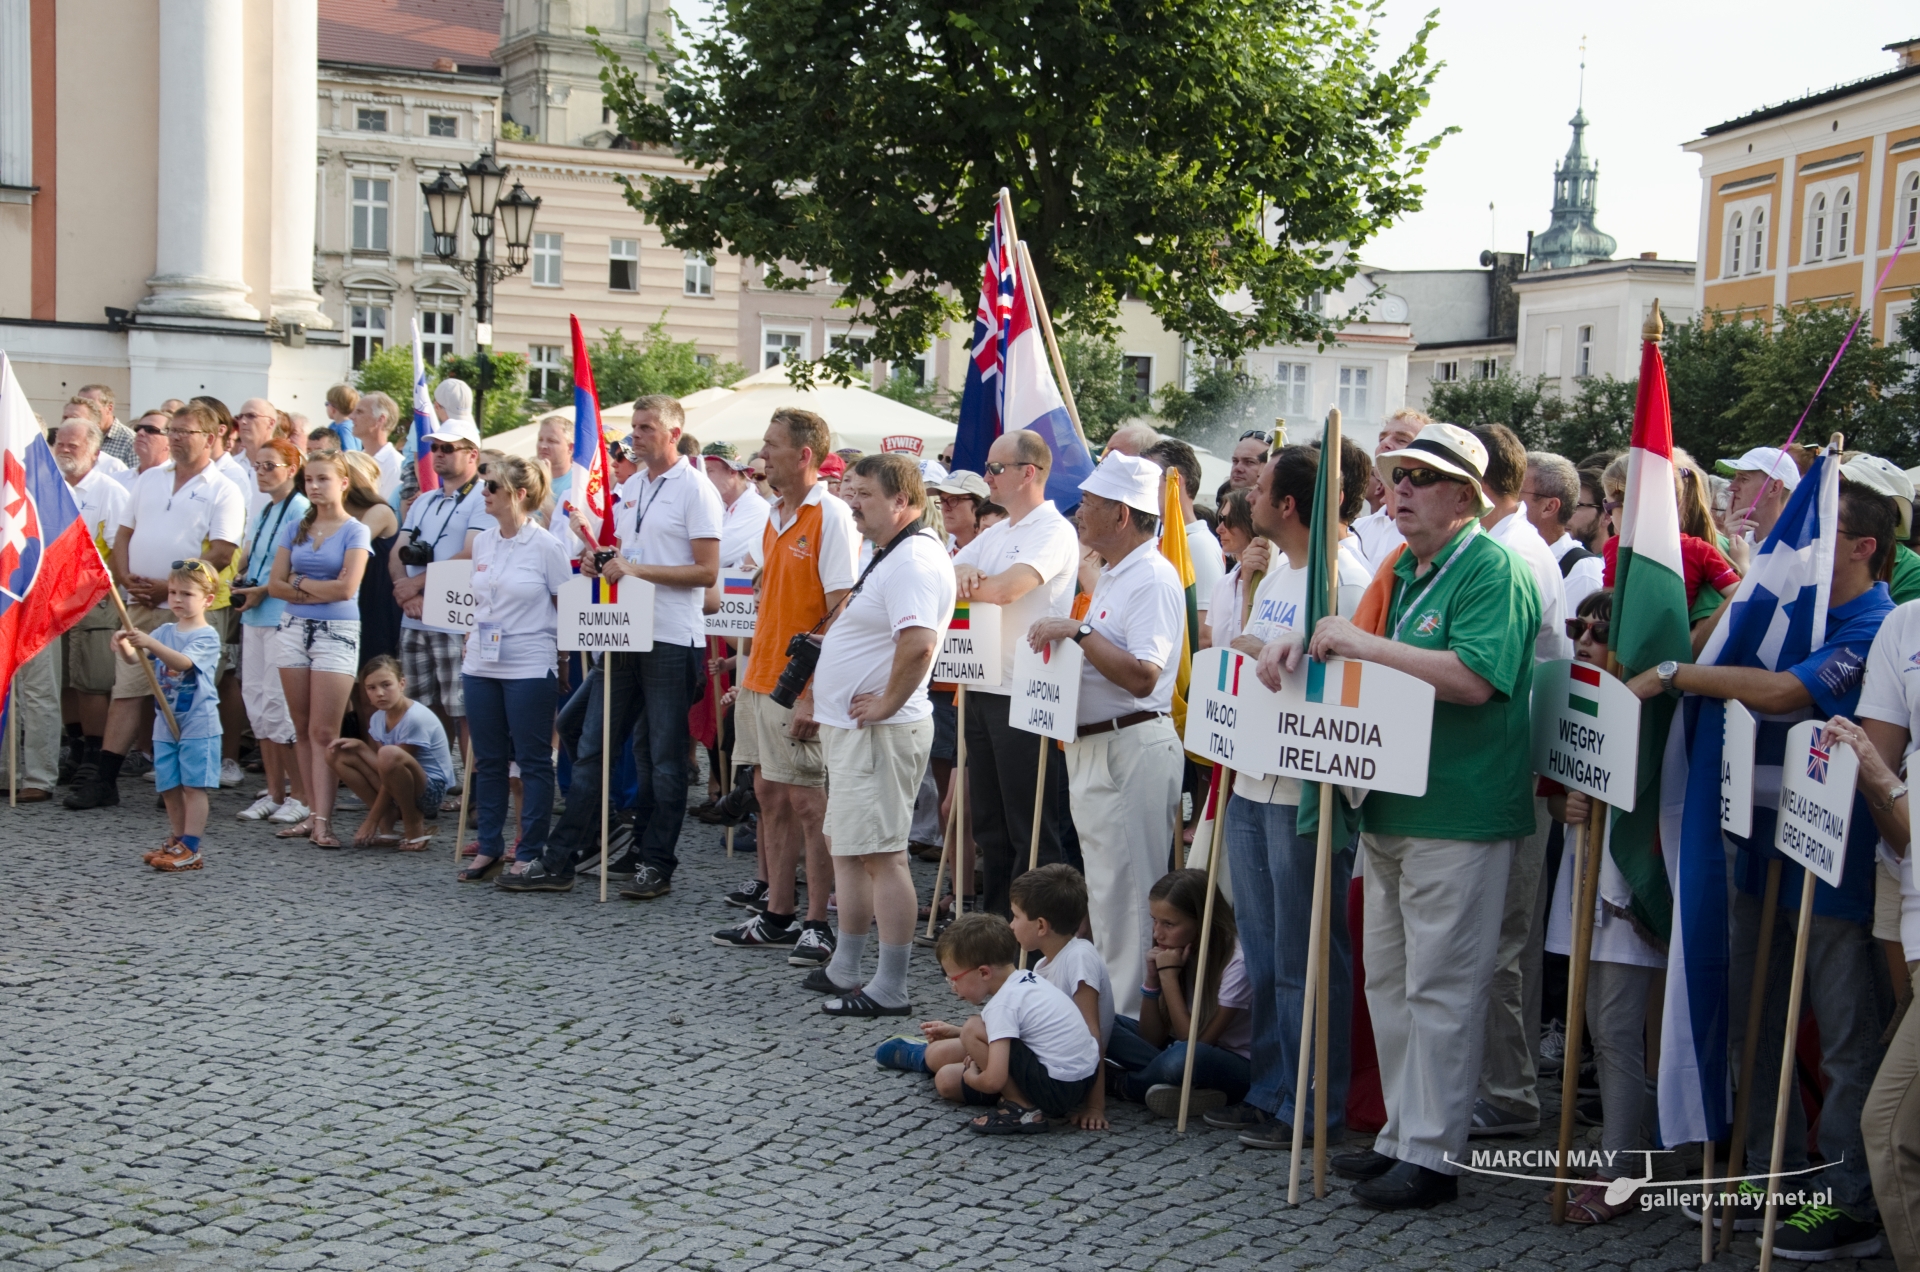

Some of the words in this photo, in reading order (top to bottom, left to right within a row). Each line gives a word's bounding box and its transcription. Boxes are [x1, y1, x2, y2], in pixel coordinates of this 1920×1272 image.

[886, 436, 920, 450] ŻYWIEC
[578, 611, 631, 626] RUMUNIA
[719, 601, 757, 615] ROSJ
[893, 614, 917, 628] anon
[1256, 599, 1297, 627] ITALIA
[578, 632, 631, 647] ROMANIA
[943, 637, 974, 655] LITWA
[1026, 678, 1060, 704] JAPONIA
[1028, 707, 1055, 731] JAPAN
[1206, 698, 1237, 730] WŁOC
[1277, 711, 1383, 748] IRLANDIA
[1559, 717, 1605, 756] WĘGRY
[1209, 732, 1235, 761] ITALY
[1278, 745, 1377, 781] IRELAND
[1548, 748, 1611, 793] HUNGARY
[1781, 785, 1807, 818] WIELKA
[1807, 801, 1844, 843] BRYTANIA
[1782, 821, 1806, 855] GREAT
[1804, 836, 1835, 874] BRITAIN
